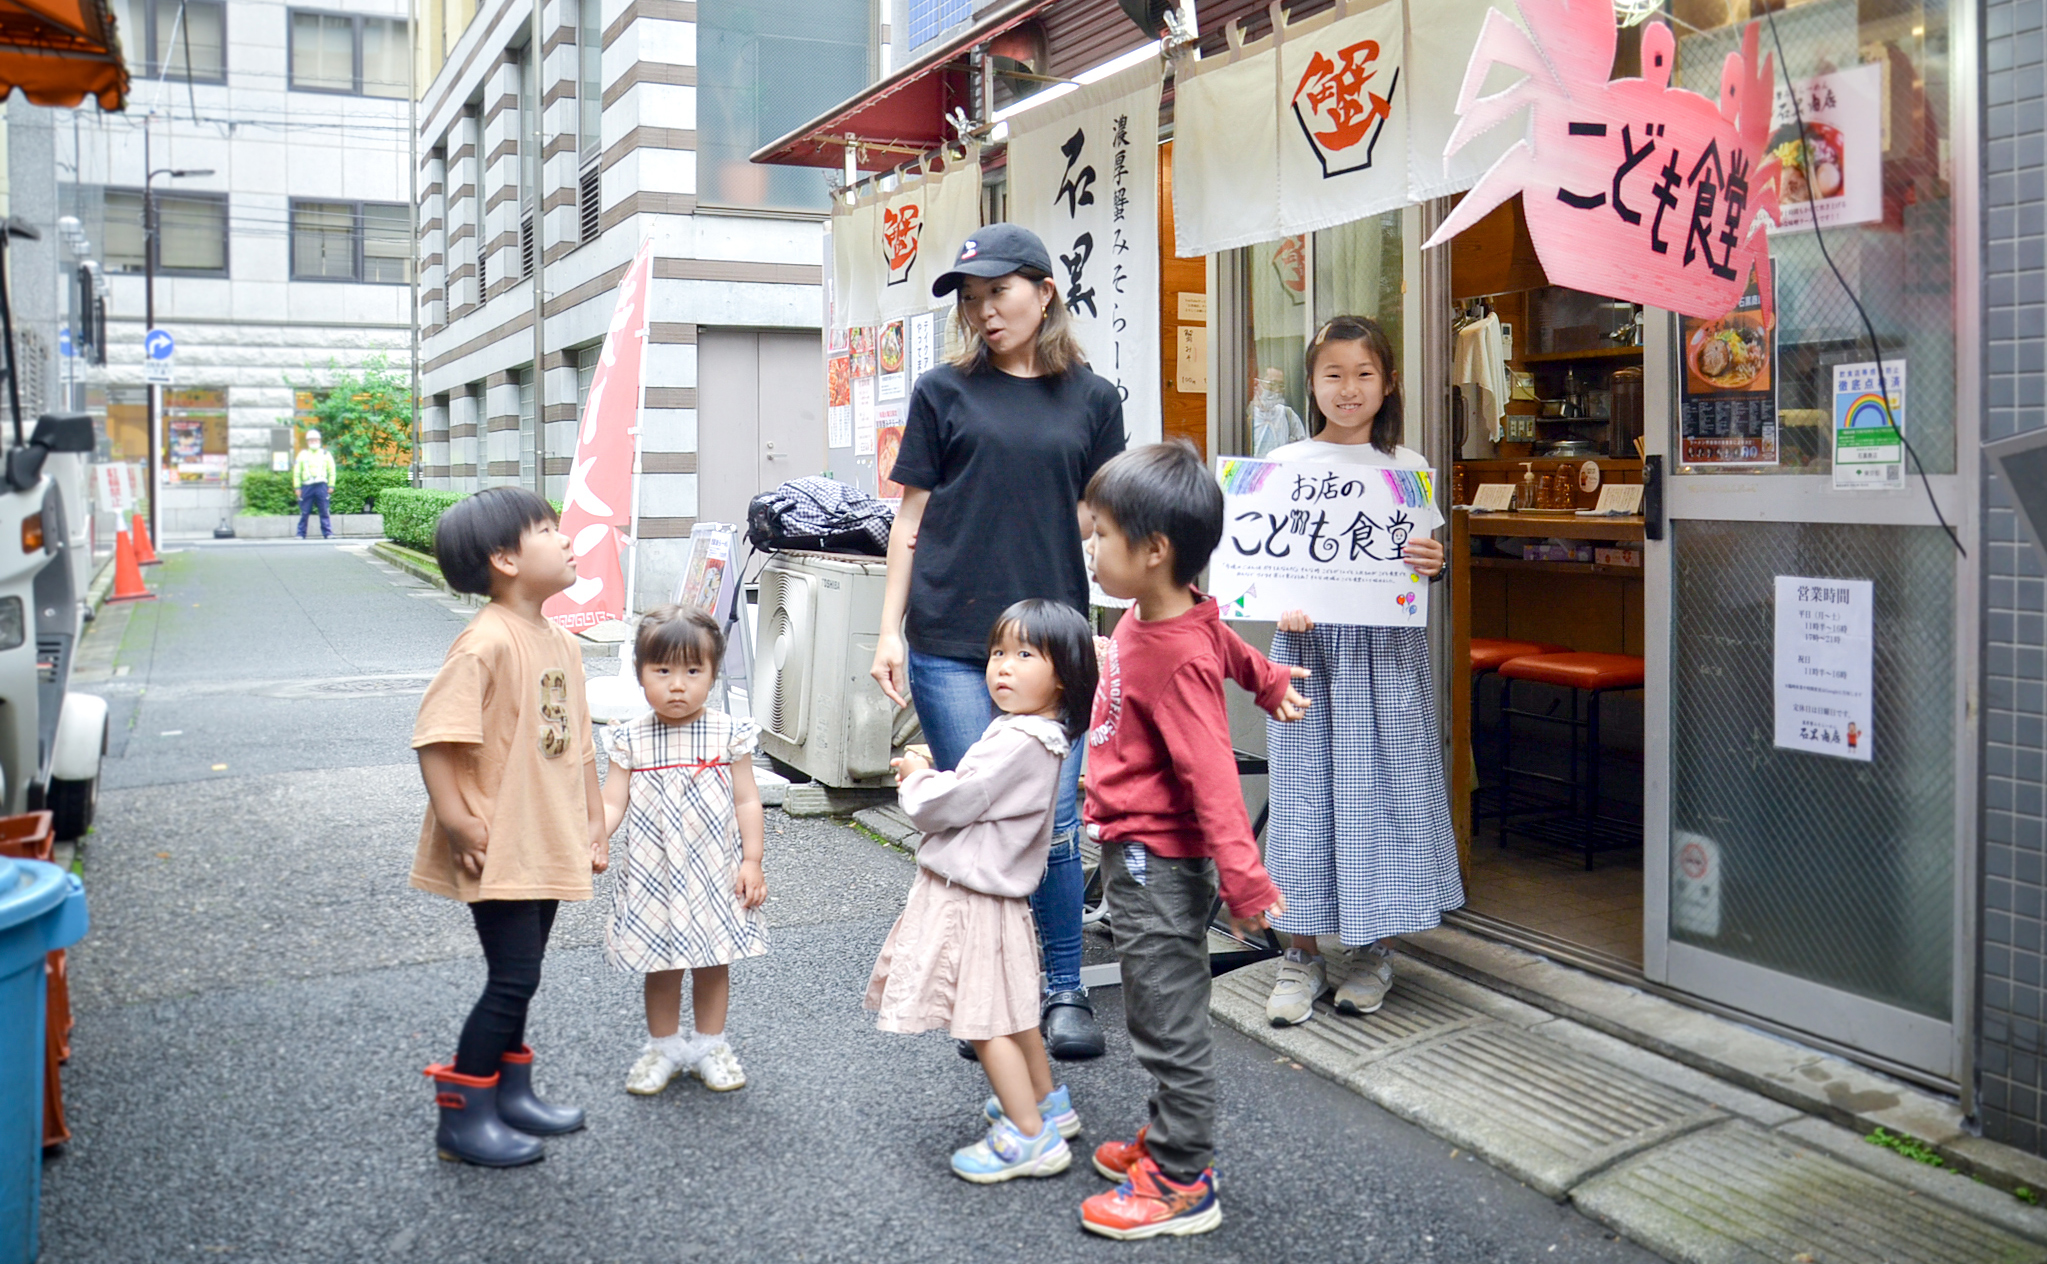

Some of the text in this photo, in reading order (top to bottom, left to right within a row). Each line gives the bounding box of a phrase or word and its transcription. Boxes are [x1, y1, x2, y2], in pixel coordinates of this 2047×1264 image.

[1556, 122, 1749, 282] こども食堂
[1054, 128, 1097, 372] 石黒
[1291, 471, 1365, 505] お店の
[1231, 509, 1414, 563] こども食堂
[1797, 585, 1850, 605] 営業時間
